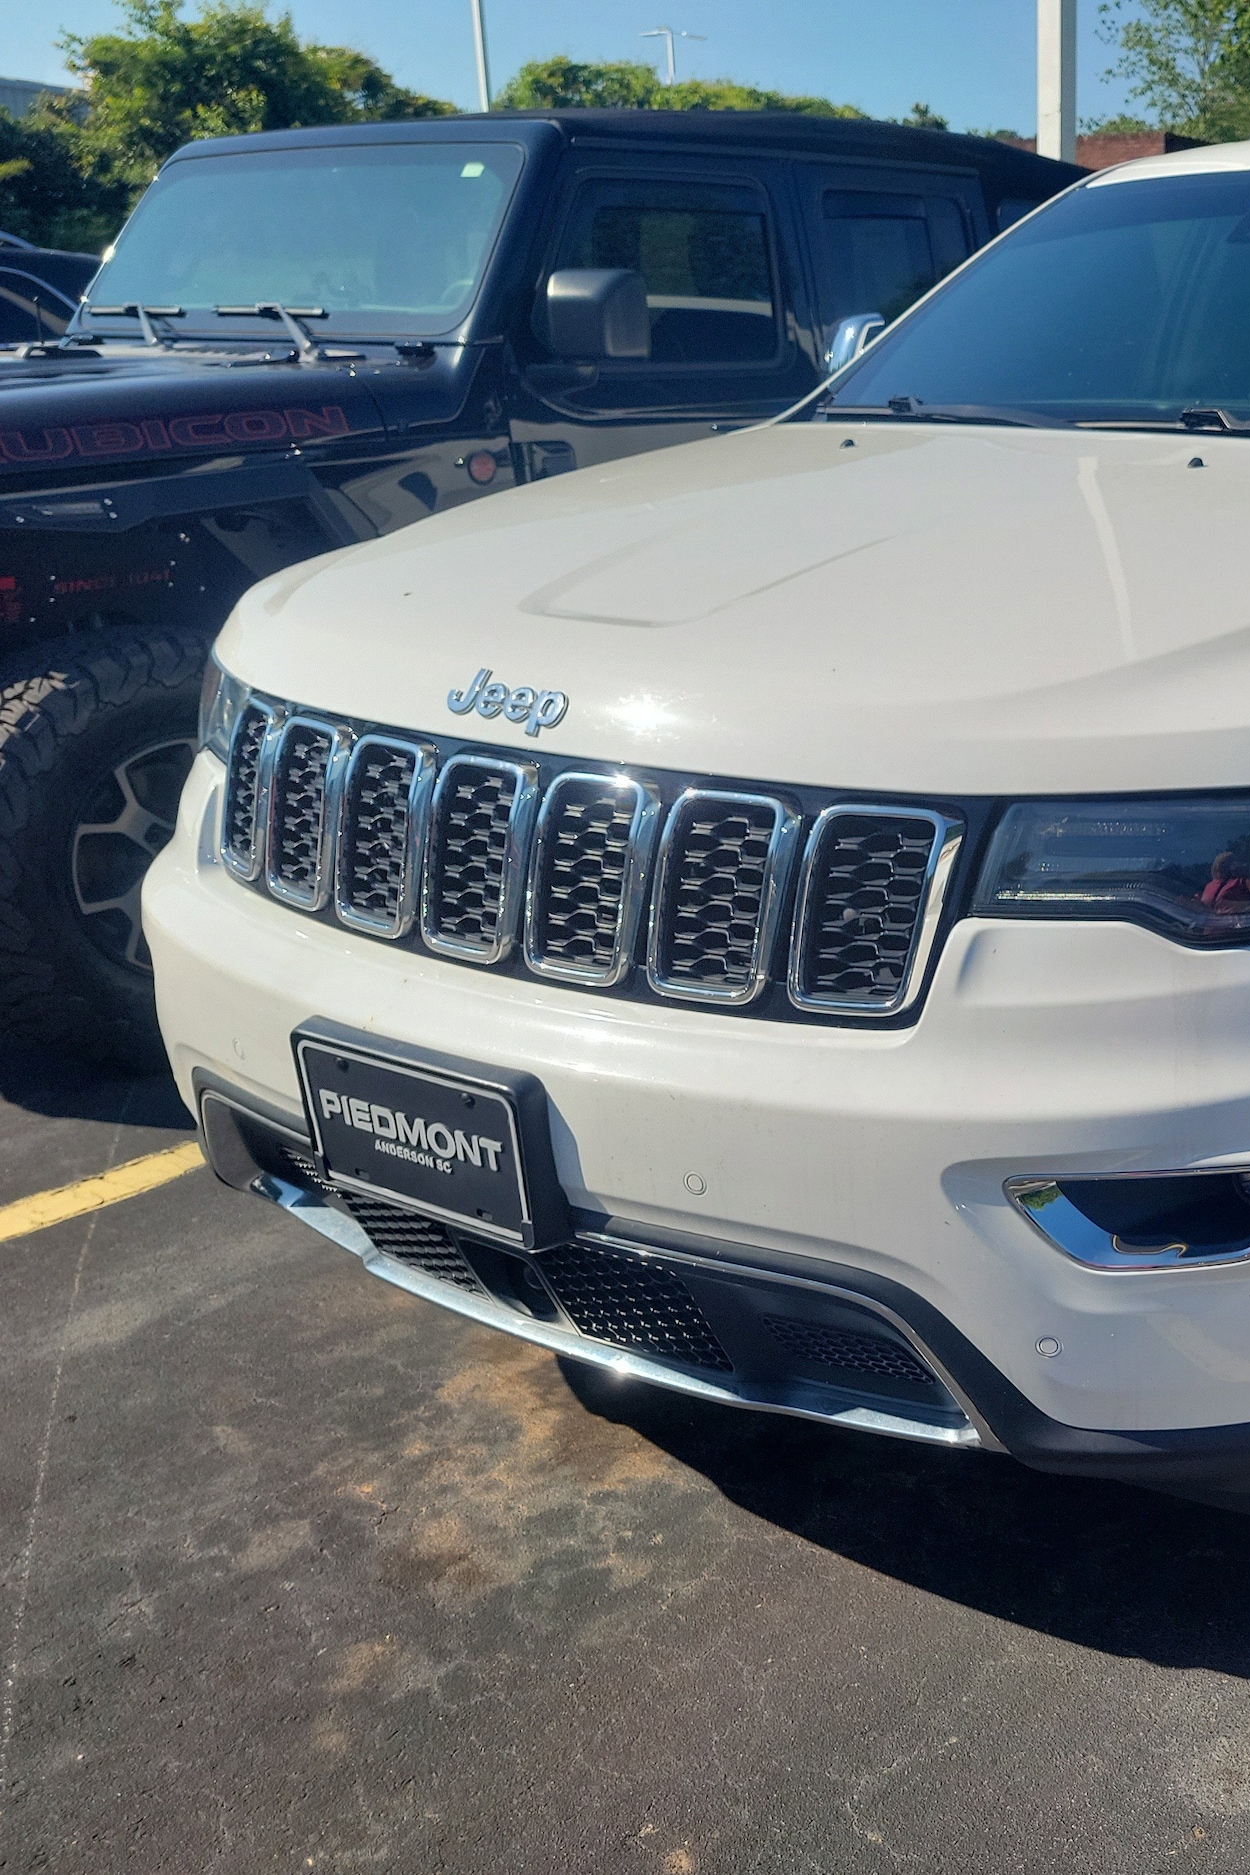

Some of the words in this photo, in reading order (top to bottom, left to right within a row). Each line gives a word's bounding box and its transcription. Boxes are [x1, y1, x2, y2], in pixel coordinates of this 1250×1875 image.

[0, 406, 350, 463] UBICON
[447, 668, 570, 738] Jeep
[318, 1088, 504, 1172] PIEDMONT
[374, 1138, 435, 1170] ANDERSON
[436, 1157, 454, 1174] SC
